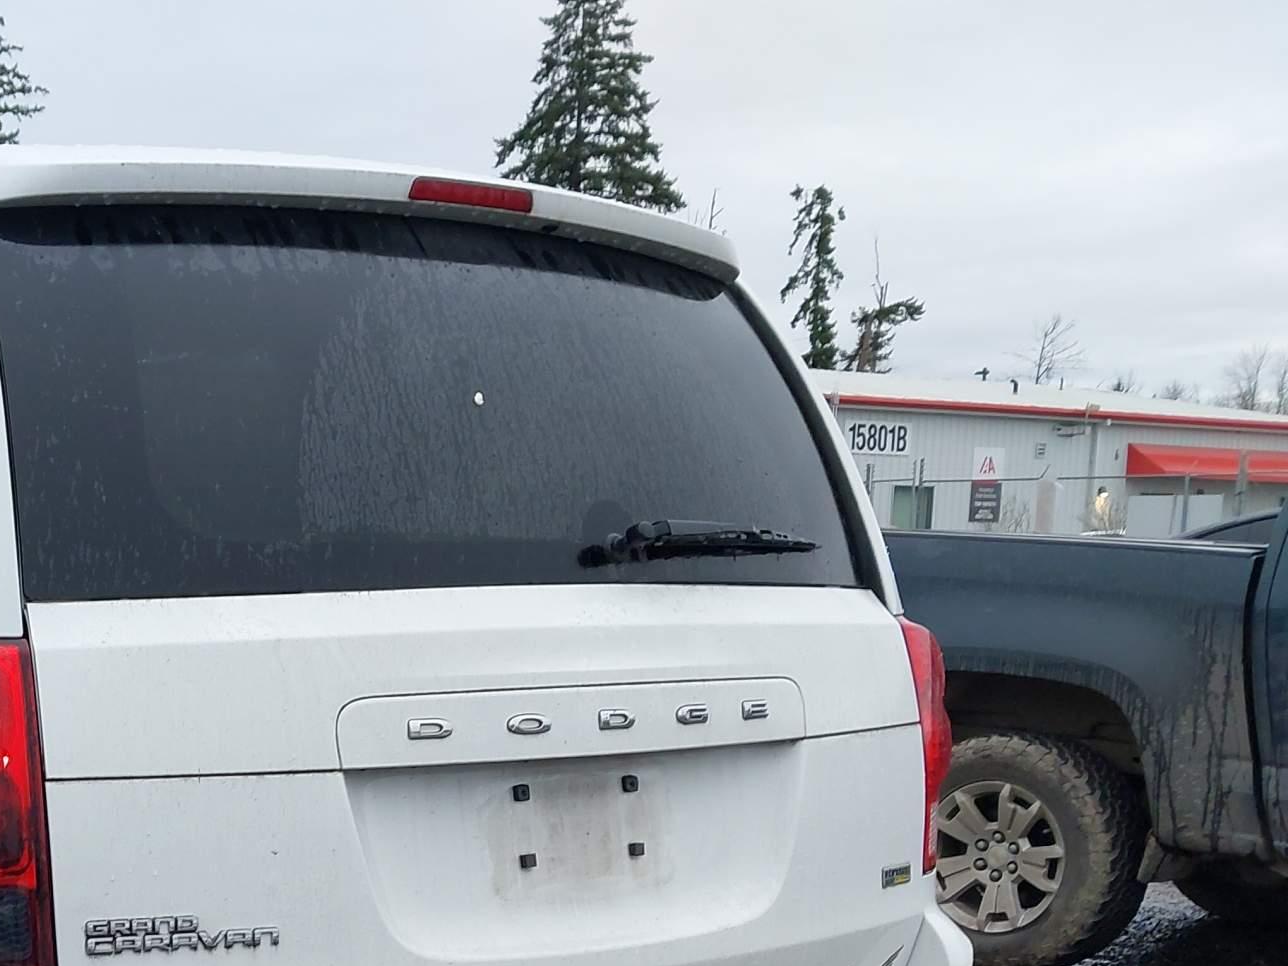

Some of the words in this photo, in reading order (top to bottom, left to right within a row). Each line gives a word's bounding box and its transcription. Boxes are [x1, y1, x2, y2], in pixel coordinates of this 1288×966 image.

[848, 422, 908, 452] 15801B
[407, 699, 769, 740] DODGE
[85, 914, 199, 937] GRAND
[86, 926, 280, 956] CARAVAN
